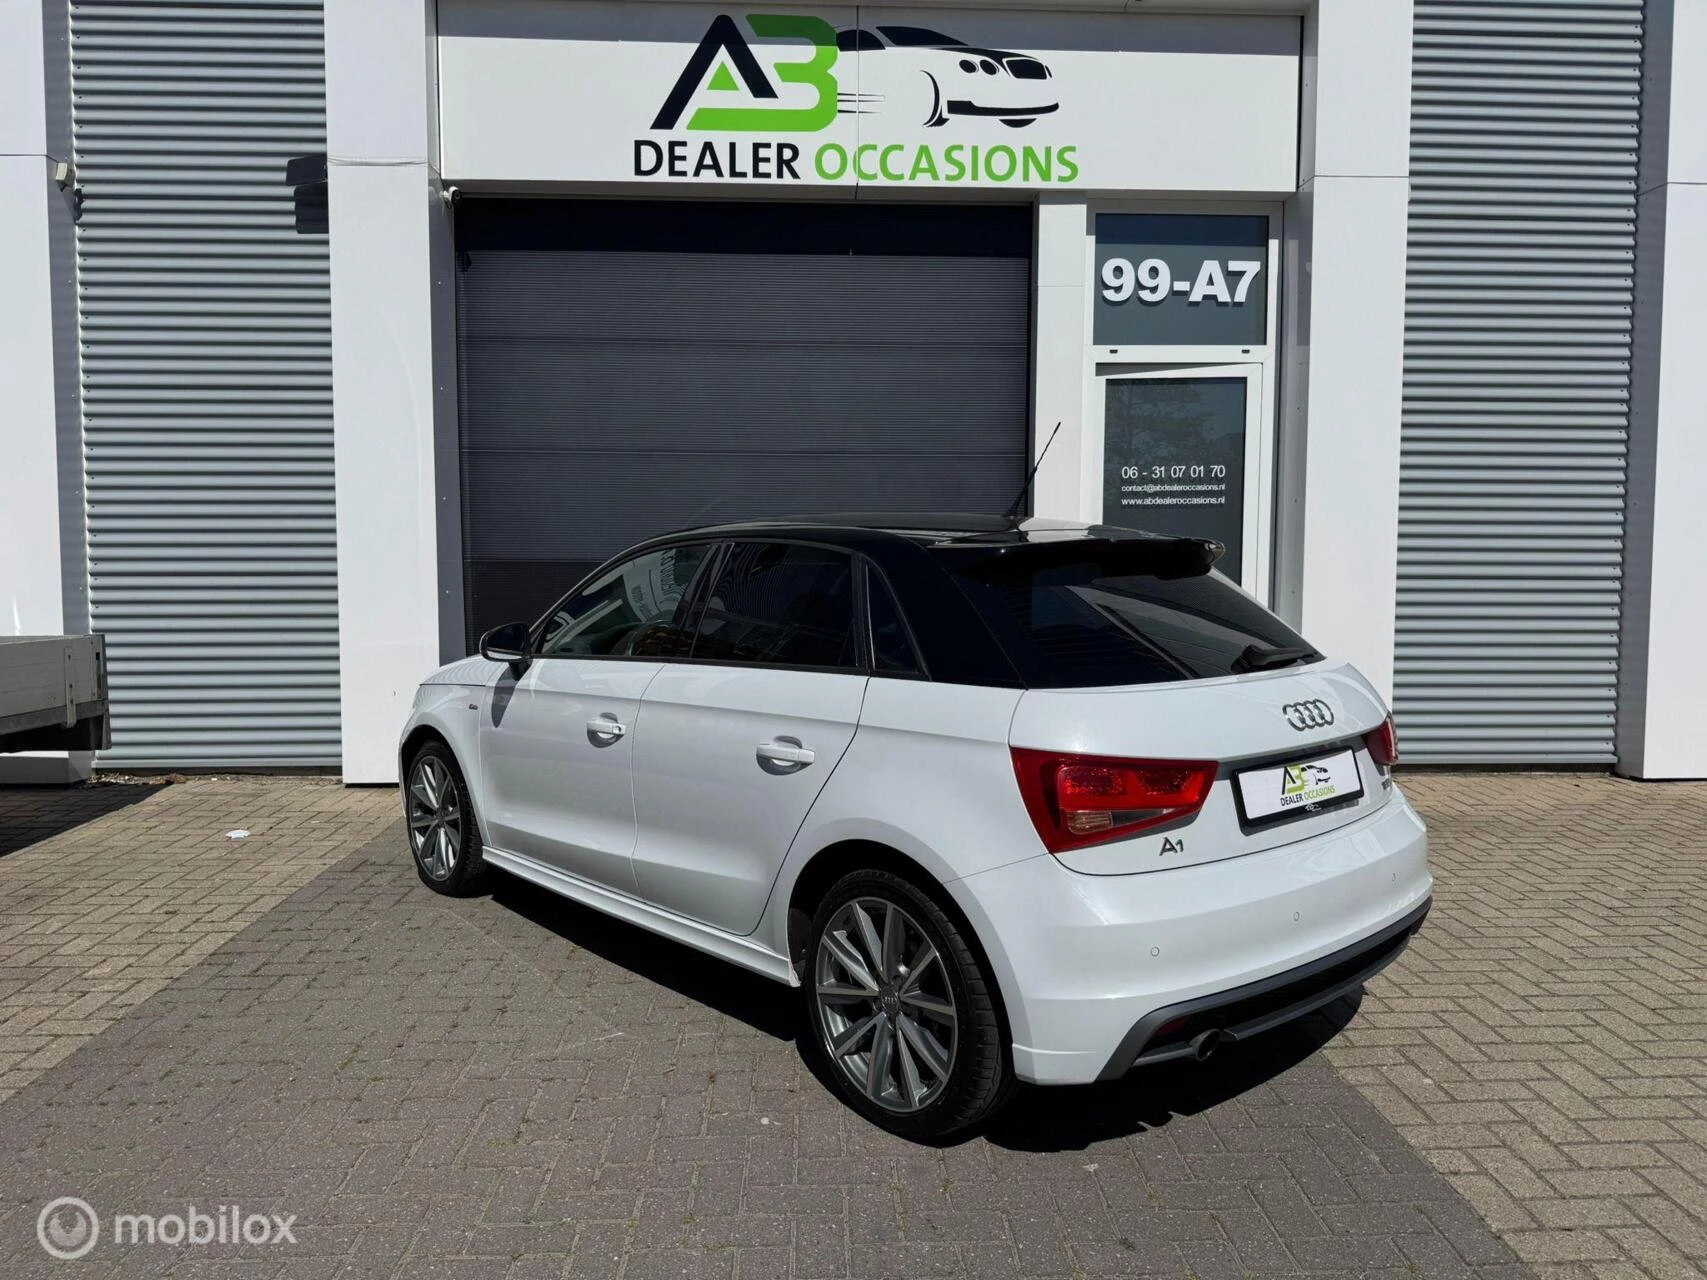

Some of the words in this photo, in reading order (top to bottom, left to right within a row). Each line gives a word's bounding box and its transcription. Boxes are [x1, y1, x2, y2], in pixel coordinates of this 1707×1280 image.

[634, 139, 800, 180] DEALER
[814, 142, 1079, 183] OCCASIONS
[1101, 258, 1261, 303] 99-A7
[1121, 466, 1139, 479] 06
[1151, 465, 1165, 479] 31
[1170, 465, 1186, 478] 07
[1190, 465, 1204, 478] 01
[1210, 464, 1226, 478] 70
[1121, 483, 1226, 493] contact@abdealeroccasions.nl
[1121, 496, 1226, 505] www.abdealeroccasions.nl
[1280, 793, 1304, 807] DEALER
[1303, 784, 1336, 801] OCCASIONS
[1159, 837, 1185, 856] A1
